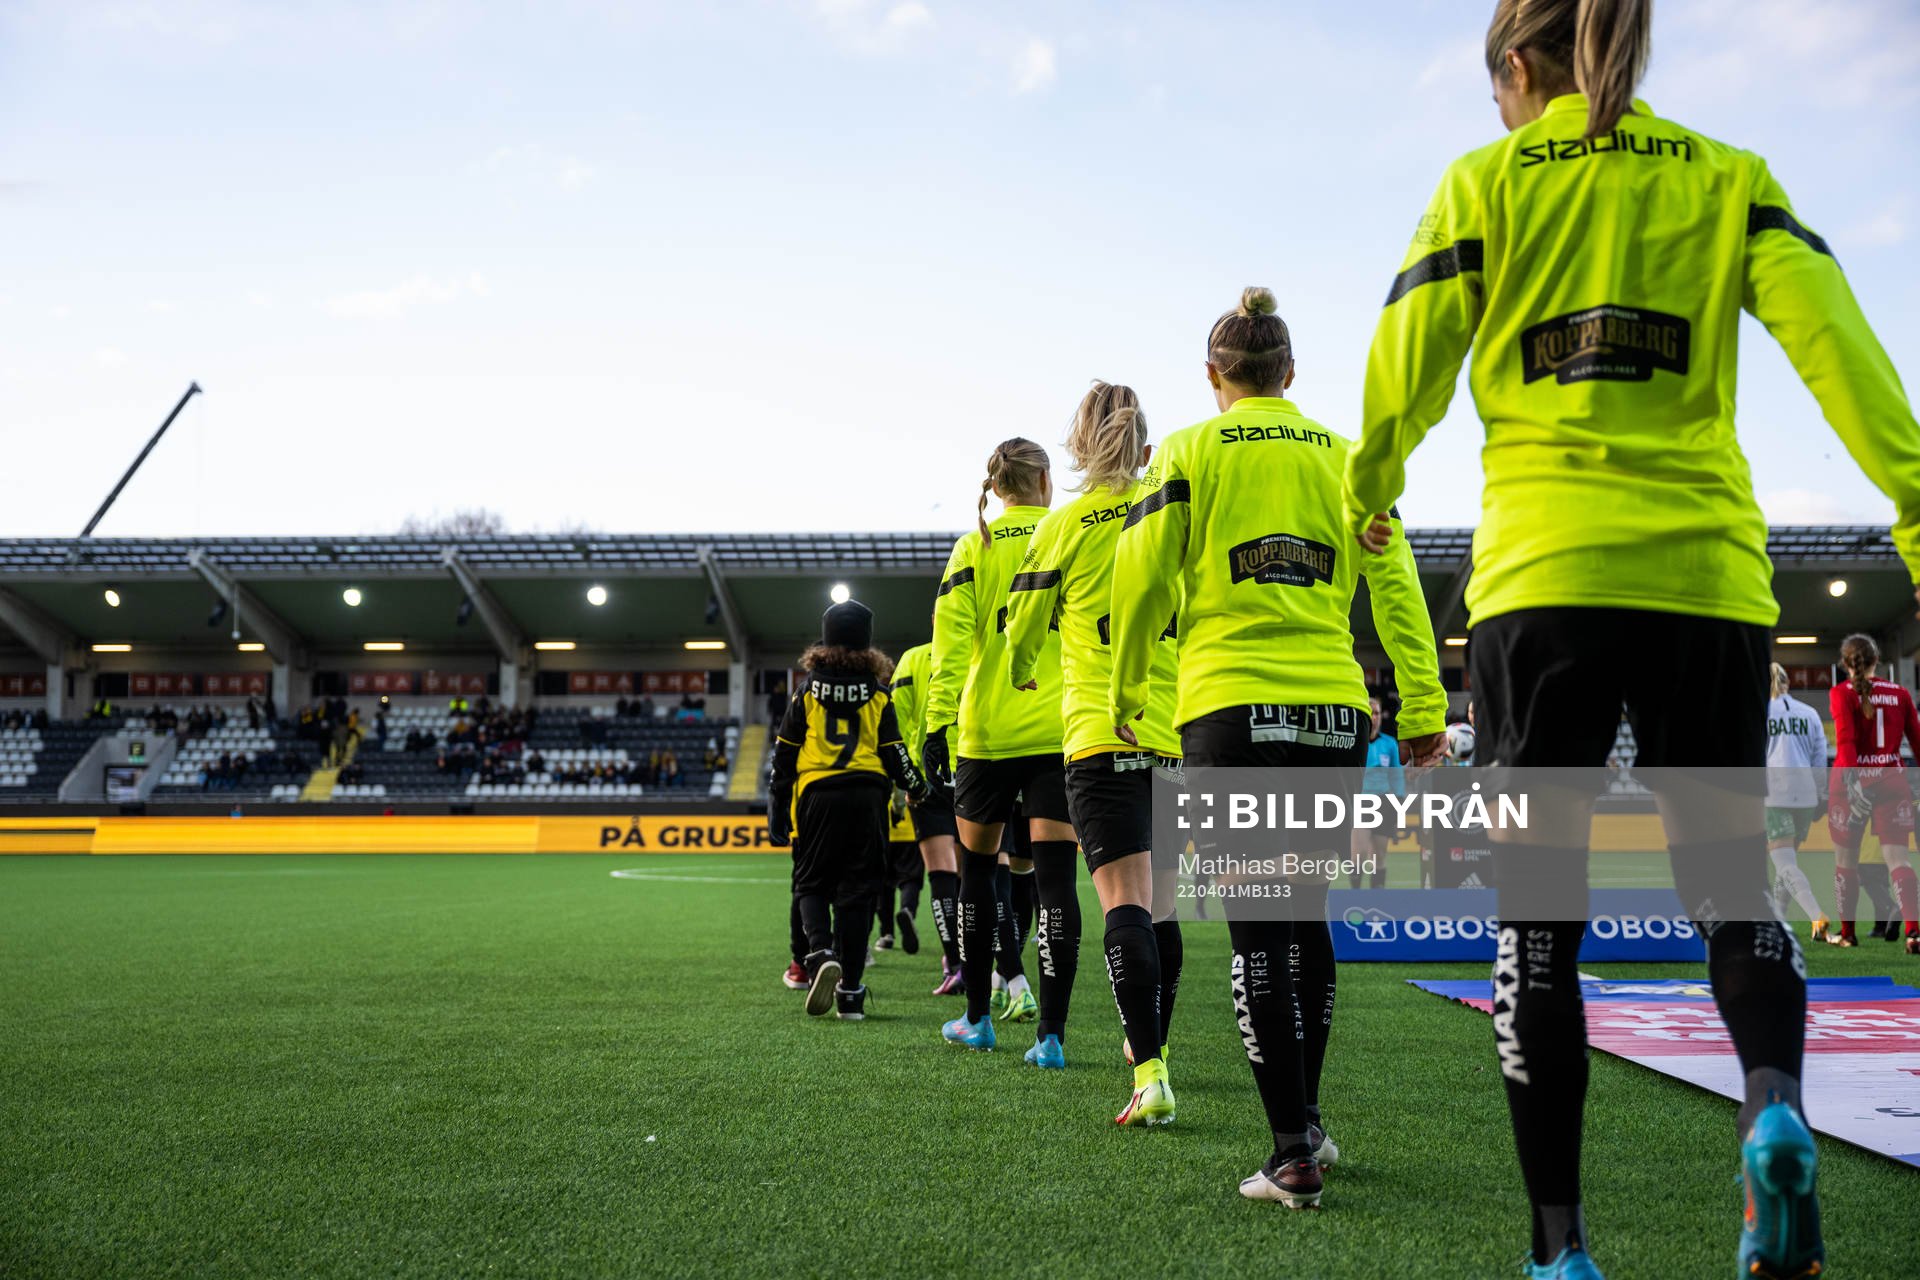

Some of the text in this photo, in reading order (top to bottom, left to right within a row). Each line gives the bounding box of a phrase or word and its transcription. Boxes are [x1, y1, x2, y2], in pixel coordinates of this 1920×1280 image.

[1520, 129, 1692, 168] stadium
[1533, 318, 1678, 370] KOPPARBERG
[1220, 424, 1331, 448] stadium
[1236, 542, 1329, 575] KOPPARBERG
[811, 680, 869, 702] SPACE
[825, 708, 862, 769] 9
[1325, 734, 1355, 749] GROUP
[1769, 717, 1809, 736] BAJEN
[1876, 708, 1885, 748] 1
[601, 816, 646, 847] PÅ
[932, 898, 951, 942] MAXXIS
[957, 902, 967, 962] MAXXIS
[965, 903, 976, 932] TYRES
[1051, 906, 1064, 941] TYRES
[1404, 915, 1498, 941] OBOS
[1591, 914, 1696, 940] OBOS
[1037, 904, 1056, 978] MAXXIS
[1527, 928, 1553, 991] TYRES
[1110, 945, 1126, 984] TYRES
[1250, 951, 1271, 998] TYRES
[1232, 950, 1264, 1064] MAXXIS
[1322, 983, 1335, 1025] TYRES
[1493, 926, 1530, 1086] MAXXIS
